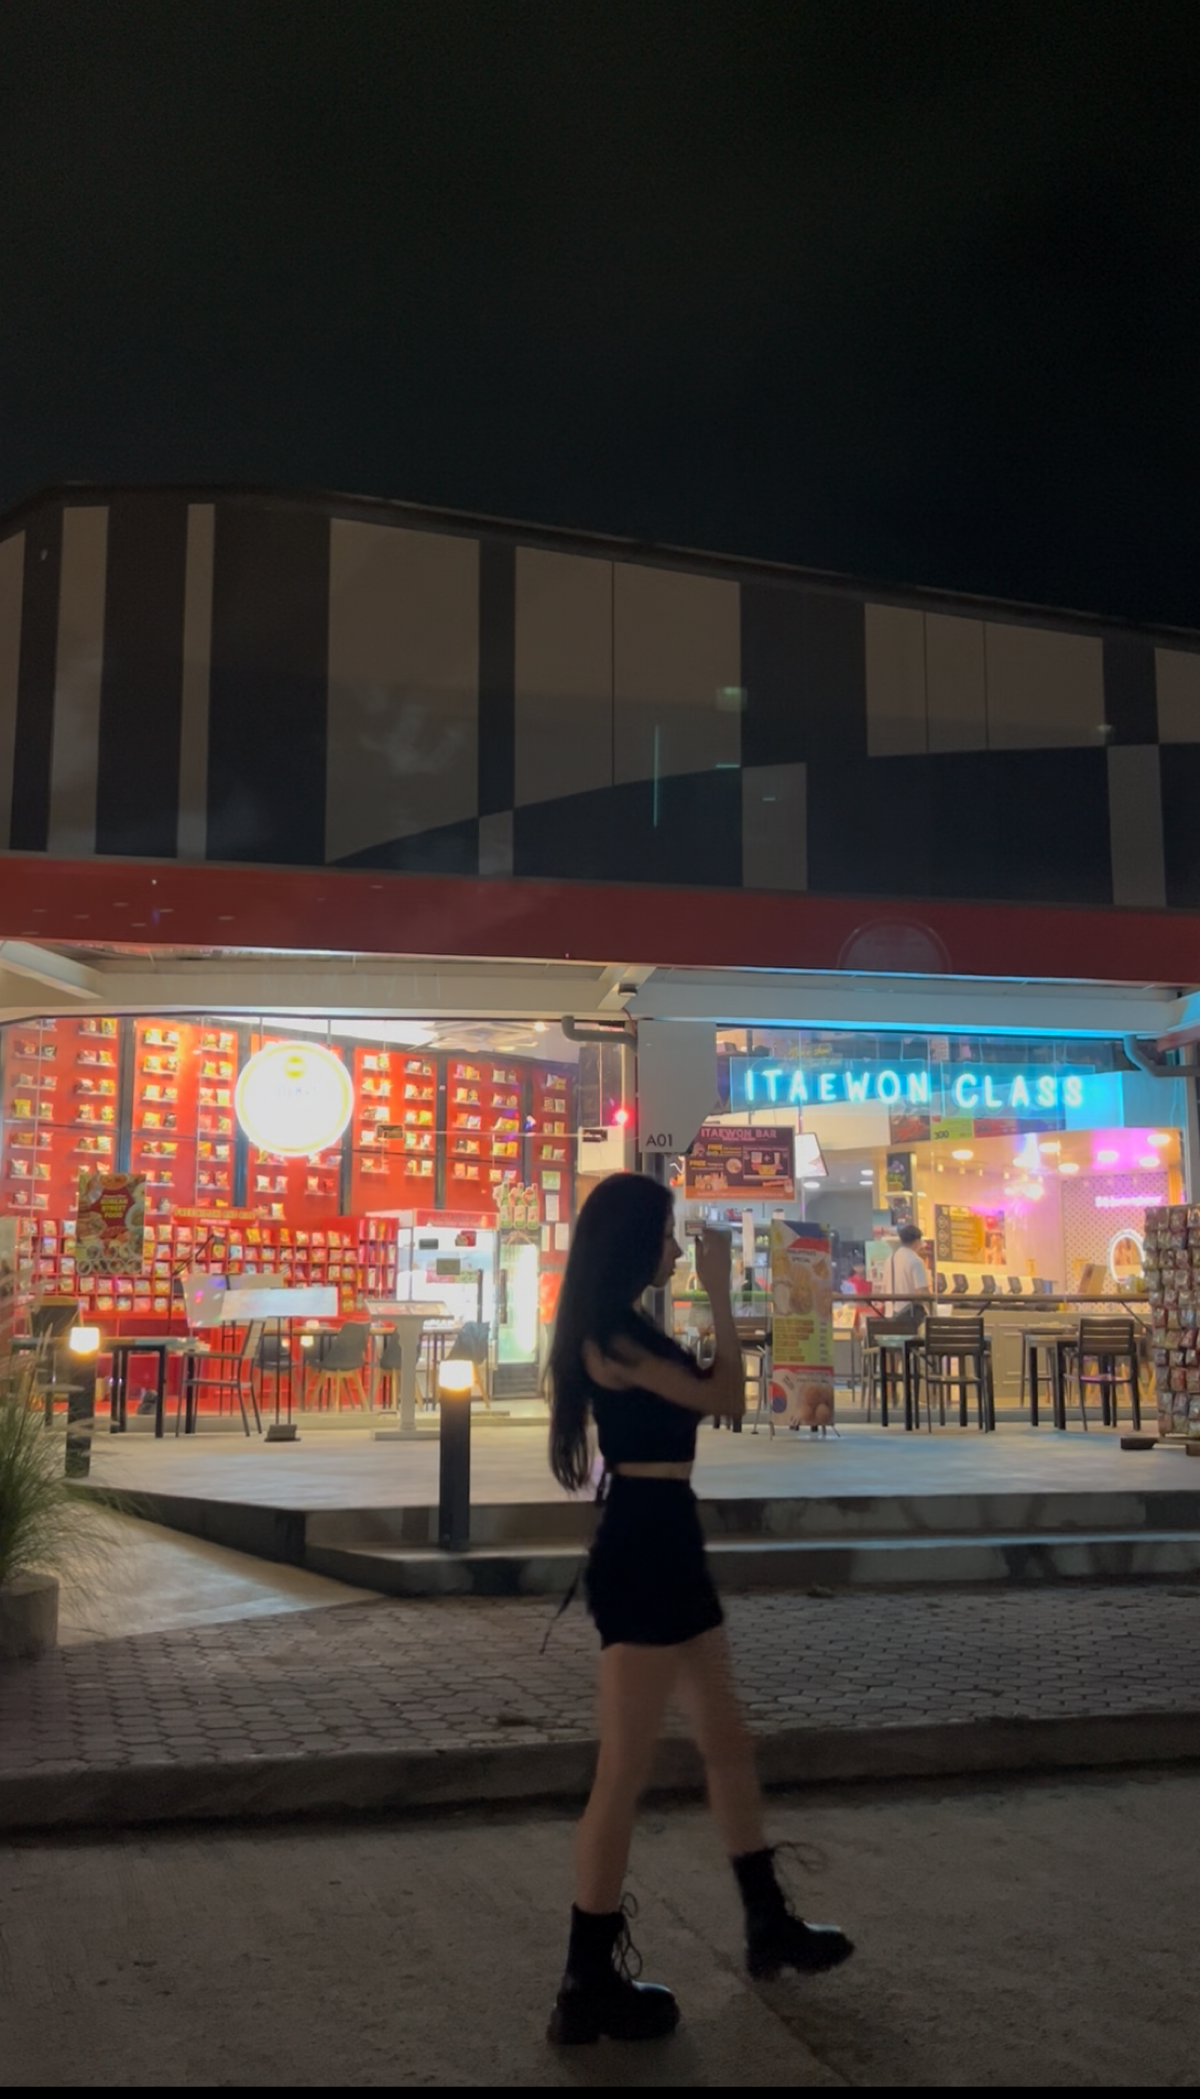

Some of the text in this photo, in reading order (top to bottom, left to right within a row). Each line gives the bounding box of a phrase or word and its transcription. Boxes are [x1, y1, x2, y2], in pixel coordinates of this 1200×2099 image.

[746, 1069, 1083, 1107] ITAEWON CLASS
[646, 1133, 673, 1147] A01
[701, 1128, 777, 1138] ITAEWON BAR
